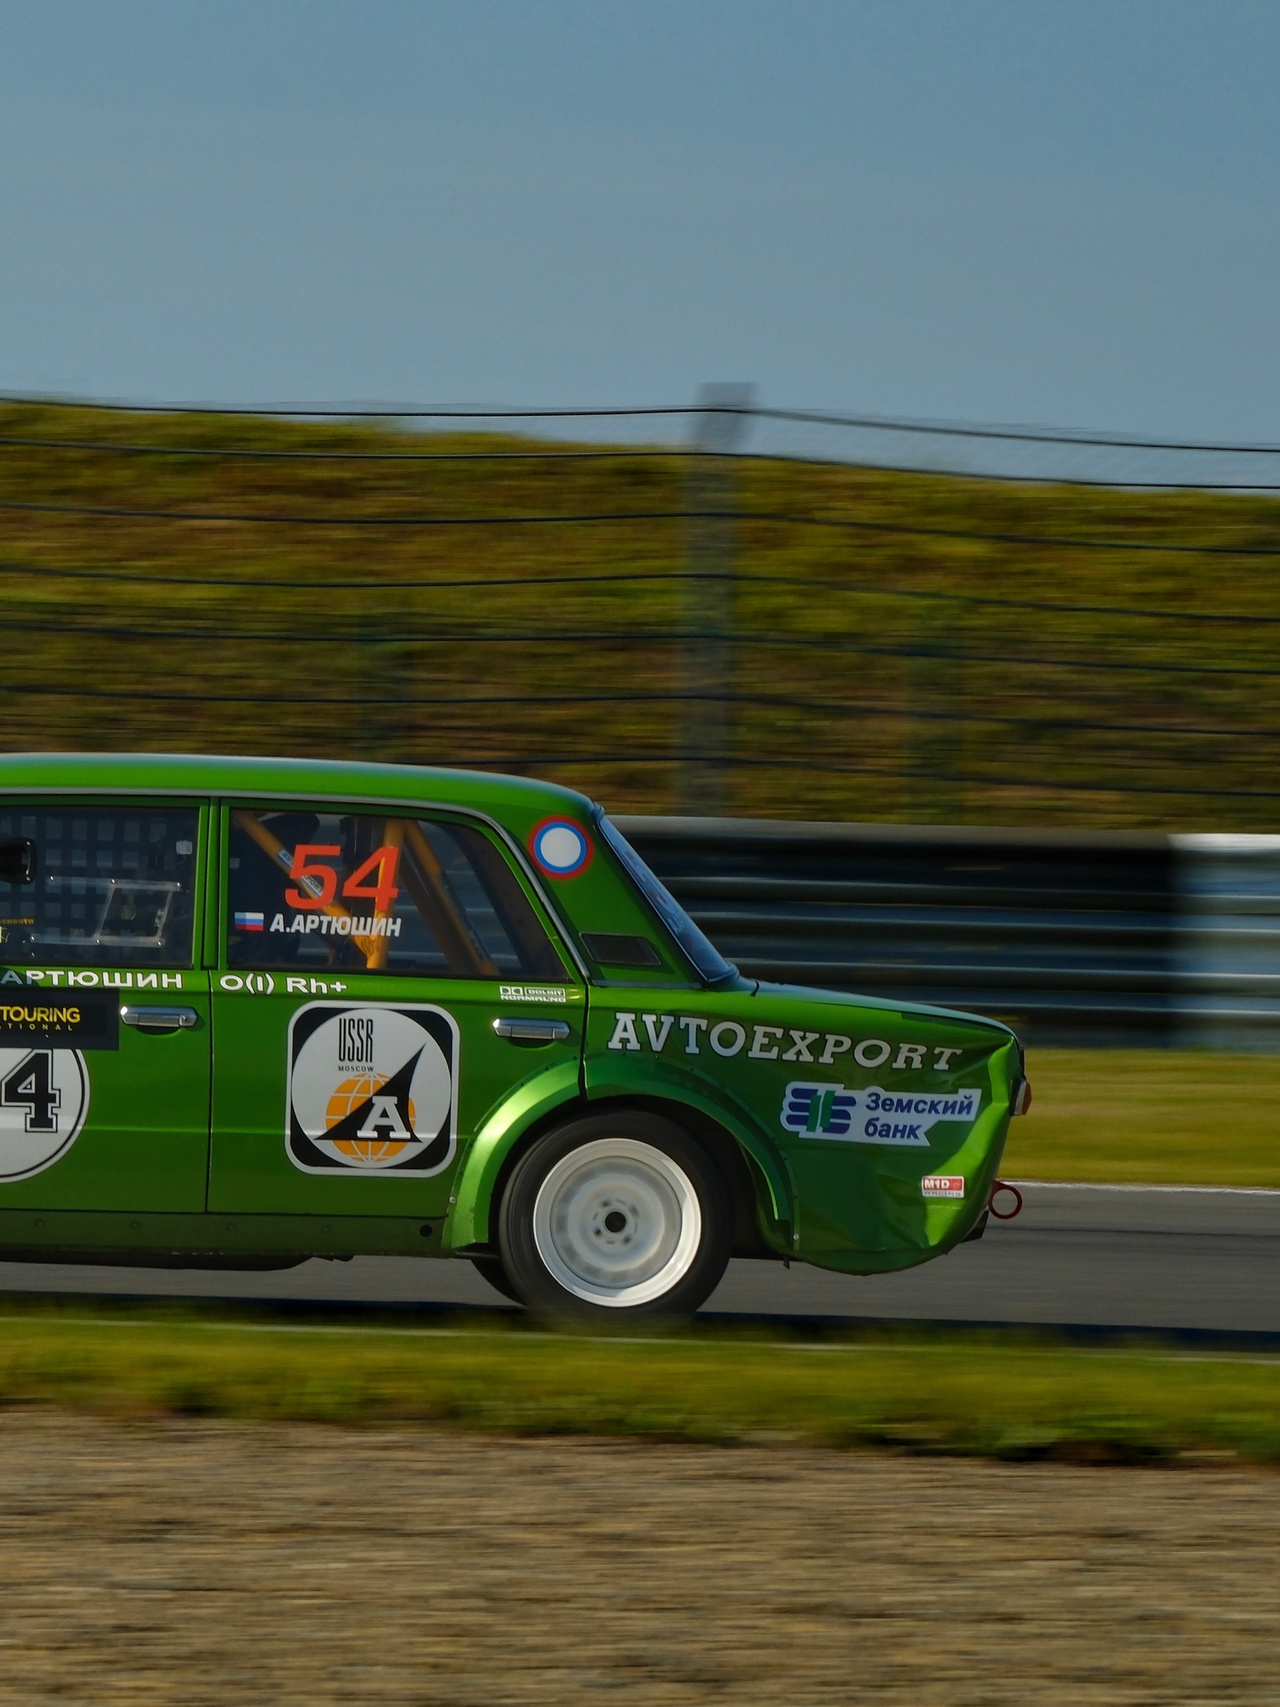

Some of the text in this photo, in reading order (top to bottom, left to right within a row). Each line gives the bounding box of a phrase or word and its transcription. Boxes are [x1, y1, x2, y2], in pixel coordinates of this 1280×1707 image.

[285, 844, 399, 911] 54
[270, 913, 402, 937] А.АРТЮШИН
[0, 970, 183, 989] АРТЮШИН
[286, 977, 347, 994] Rh+
[338, 1018, 374, 1063] USSR
[607, 1012, 964, 1071] AVTOEXPORT
[338, 1065, 375, 1073] MOSCOW
[865, 1092, 973, 1115] Земский
[357, 1096, 411, 1139] A
[864, 1116, 922, 1140] банк
